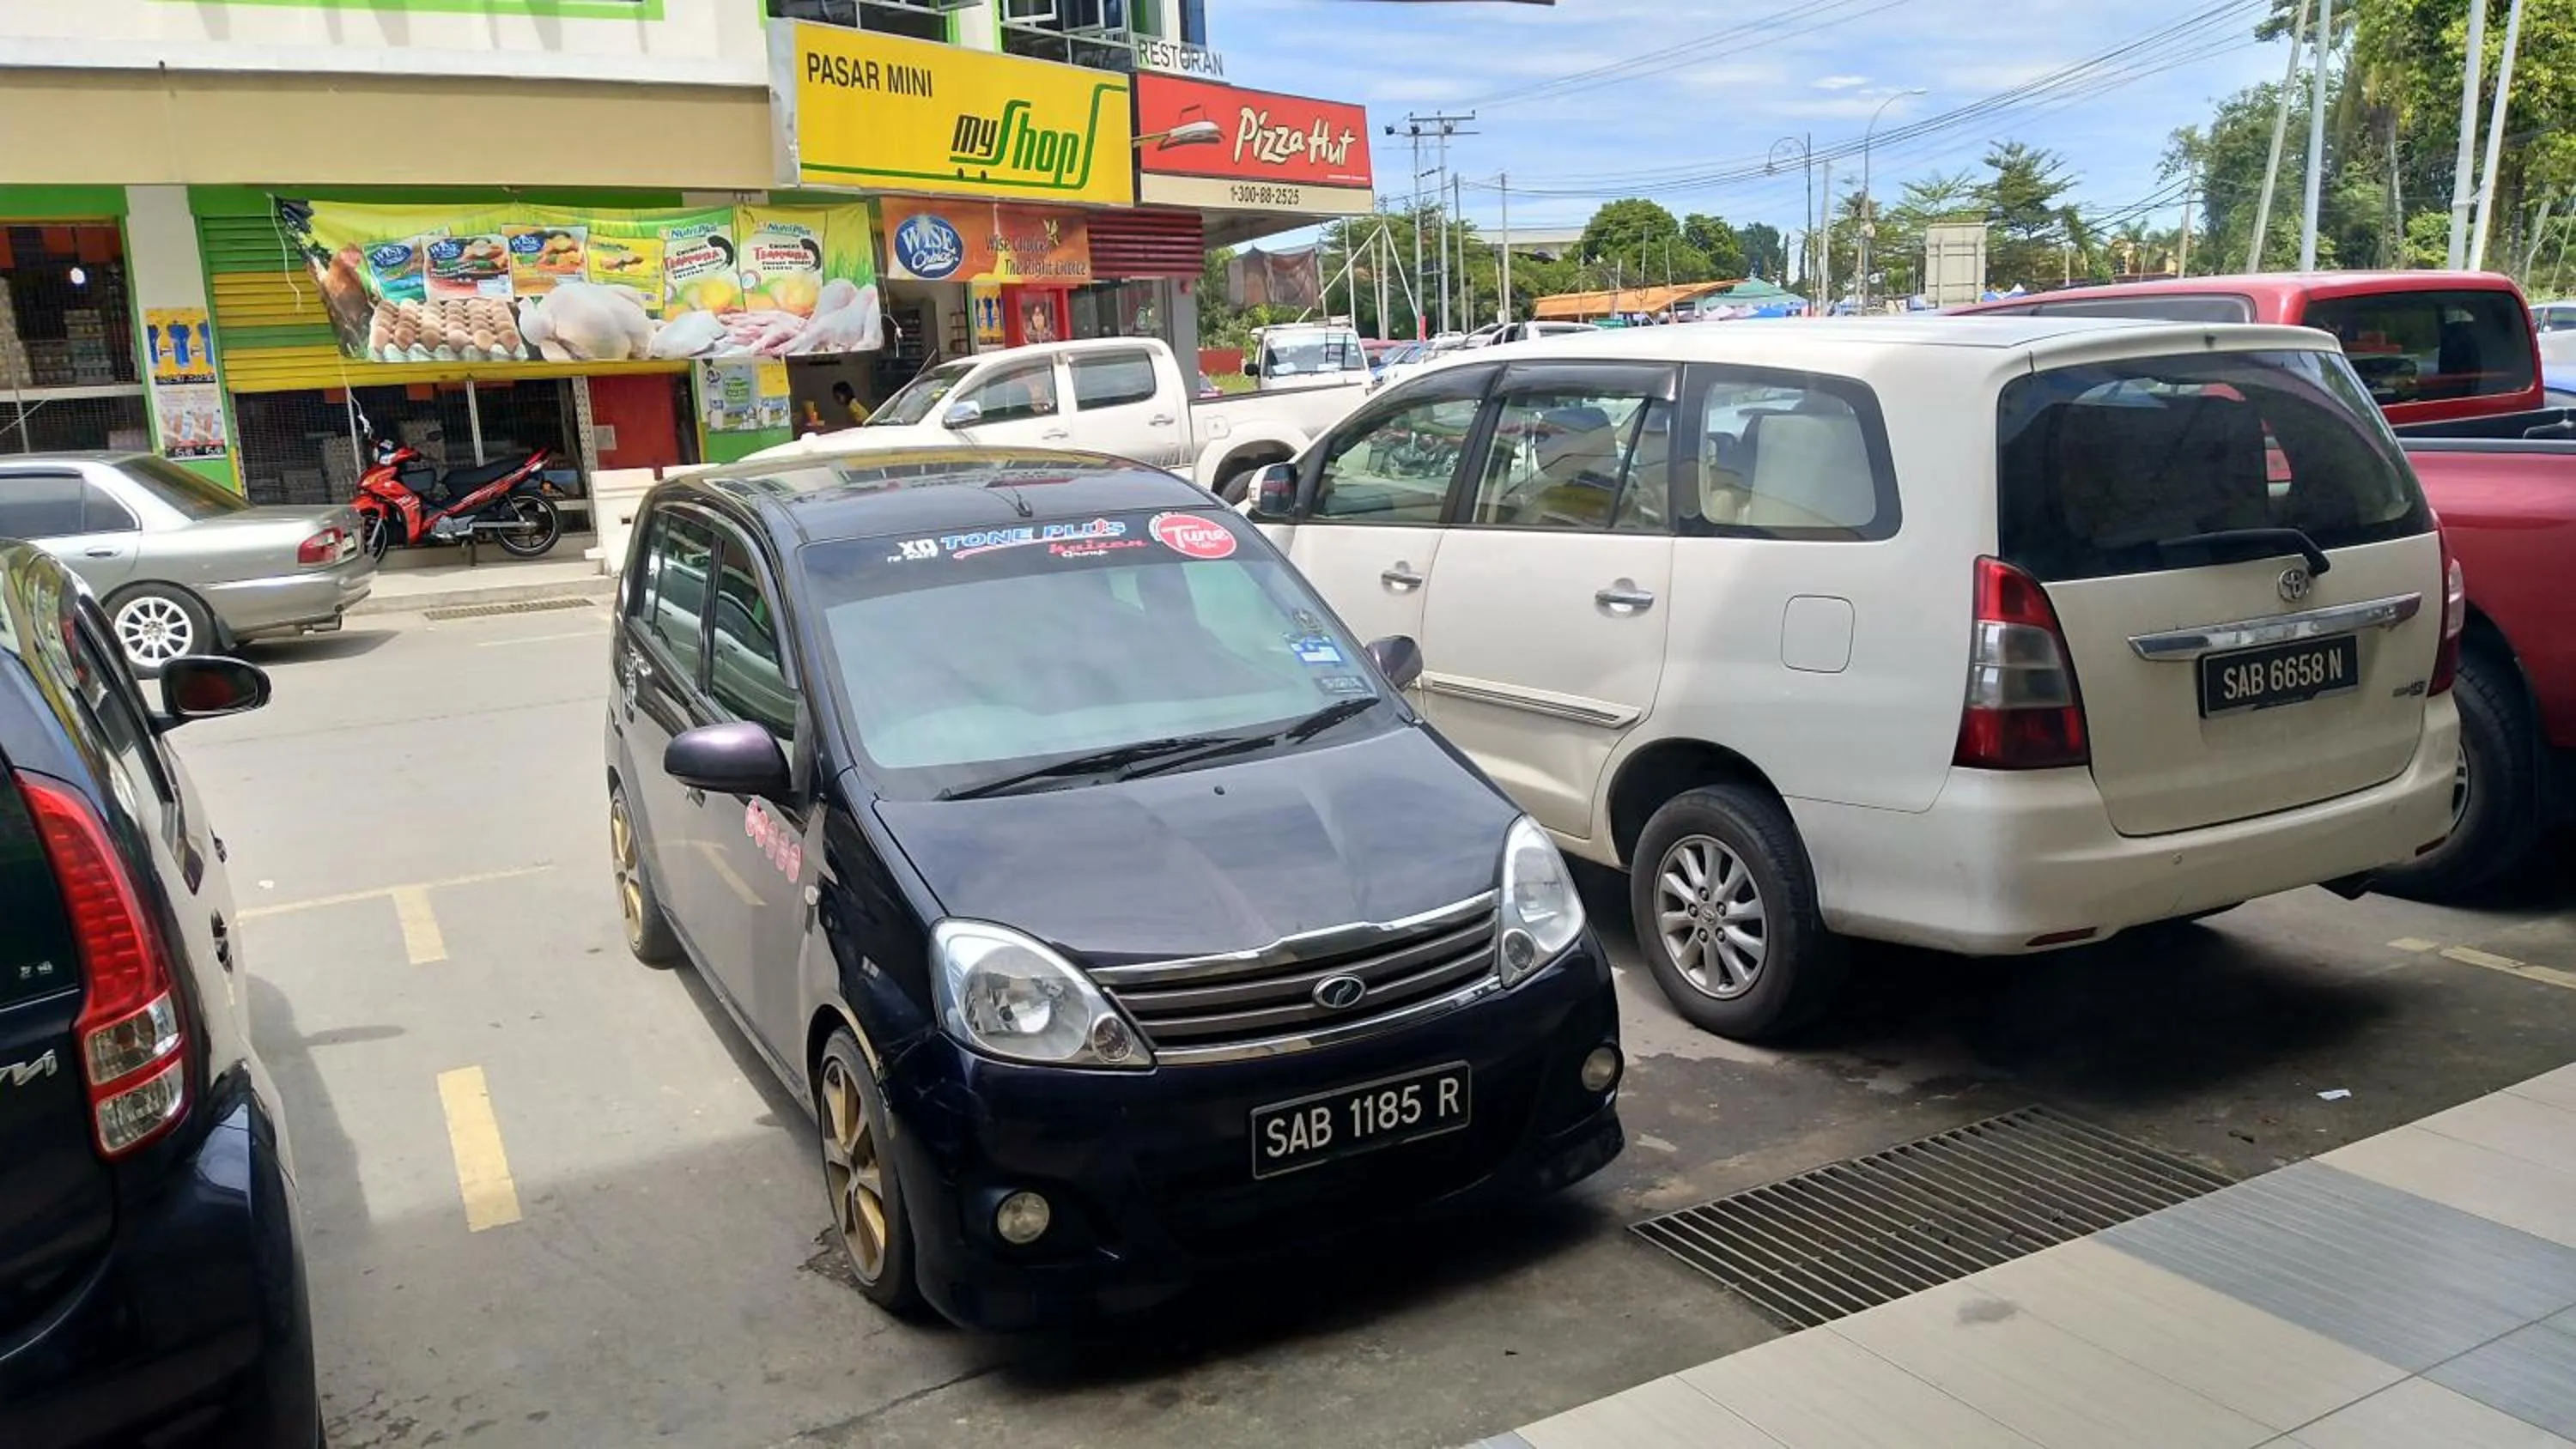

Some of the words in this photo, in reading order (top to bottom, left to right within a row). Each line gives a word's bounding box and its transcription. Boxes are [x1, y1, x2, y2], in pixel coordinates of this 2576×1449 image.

[807, 52, 880, 91] PASAR
[887, 64, 933, 98] MINI
[1139, 40, 1224, 76] RESTORAN
[1233, 107, 1305, 165] Pizza
[1308, 117, 1356, 166] Hut
[1230, 185, 1299, 205] 1-300-88-2525
[902, 223, 956, 254] WISE
[940, 526, 1033, 550] TONE
[1042, 518, 1127, 539] PLUS
[1161, 523, 1229, 550] Tune
[2223, 663, 2264, 700] SAB
[2269, 652, 2324, 691] 6658
[2329, 648, 2342, 679] N
[1267, 1107, 1333, 1158] SAB
[1350, 1085, 1422, 1137] 1185
[1438, 1077, 1460, 1117] R
